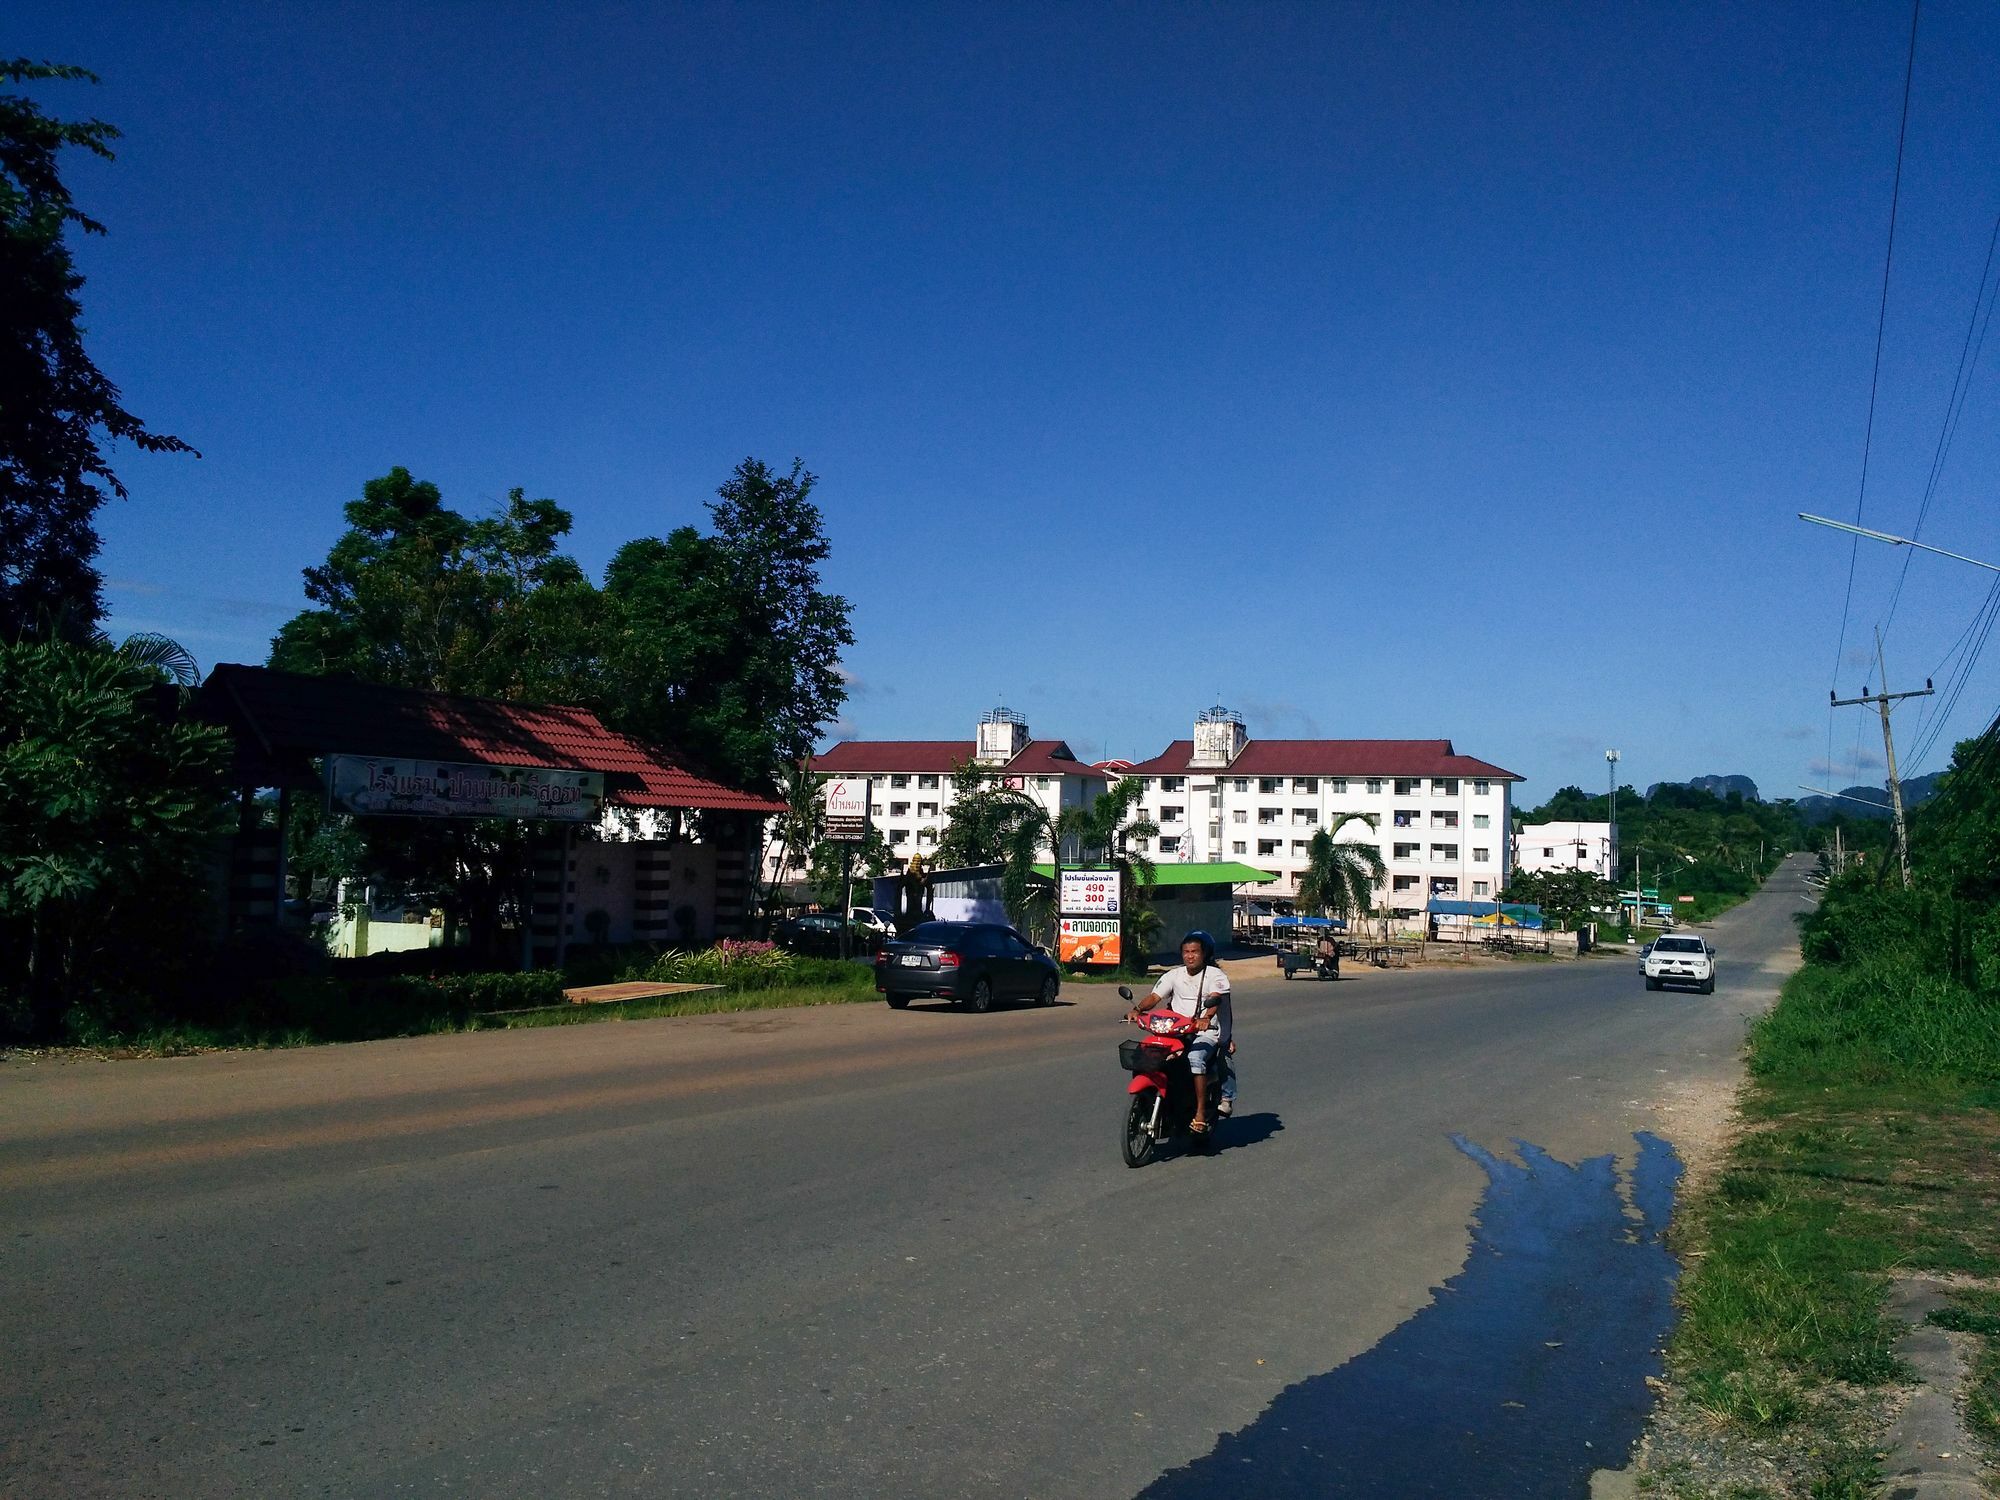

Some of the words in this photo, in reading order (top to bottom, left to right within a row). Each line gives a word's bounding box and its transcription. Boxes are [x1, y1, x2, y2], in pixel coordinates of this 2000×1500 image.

[367, 760, 438, 796] โรงแรม
[528, 774, 582, 804] รีสอร์ท
[1064, 873, 1114, 881] โปรโมชั่นห้องพัก
[1085, 883, 1105, 892] 490
[1085, 894, 1104, 902] 300
[1072, 920, 1118, 933] ลานจอดรถ
